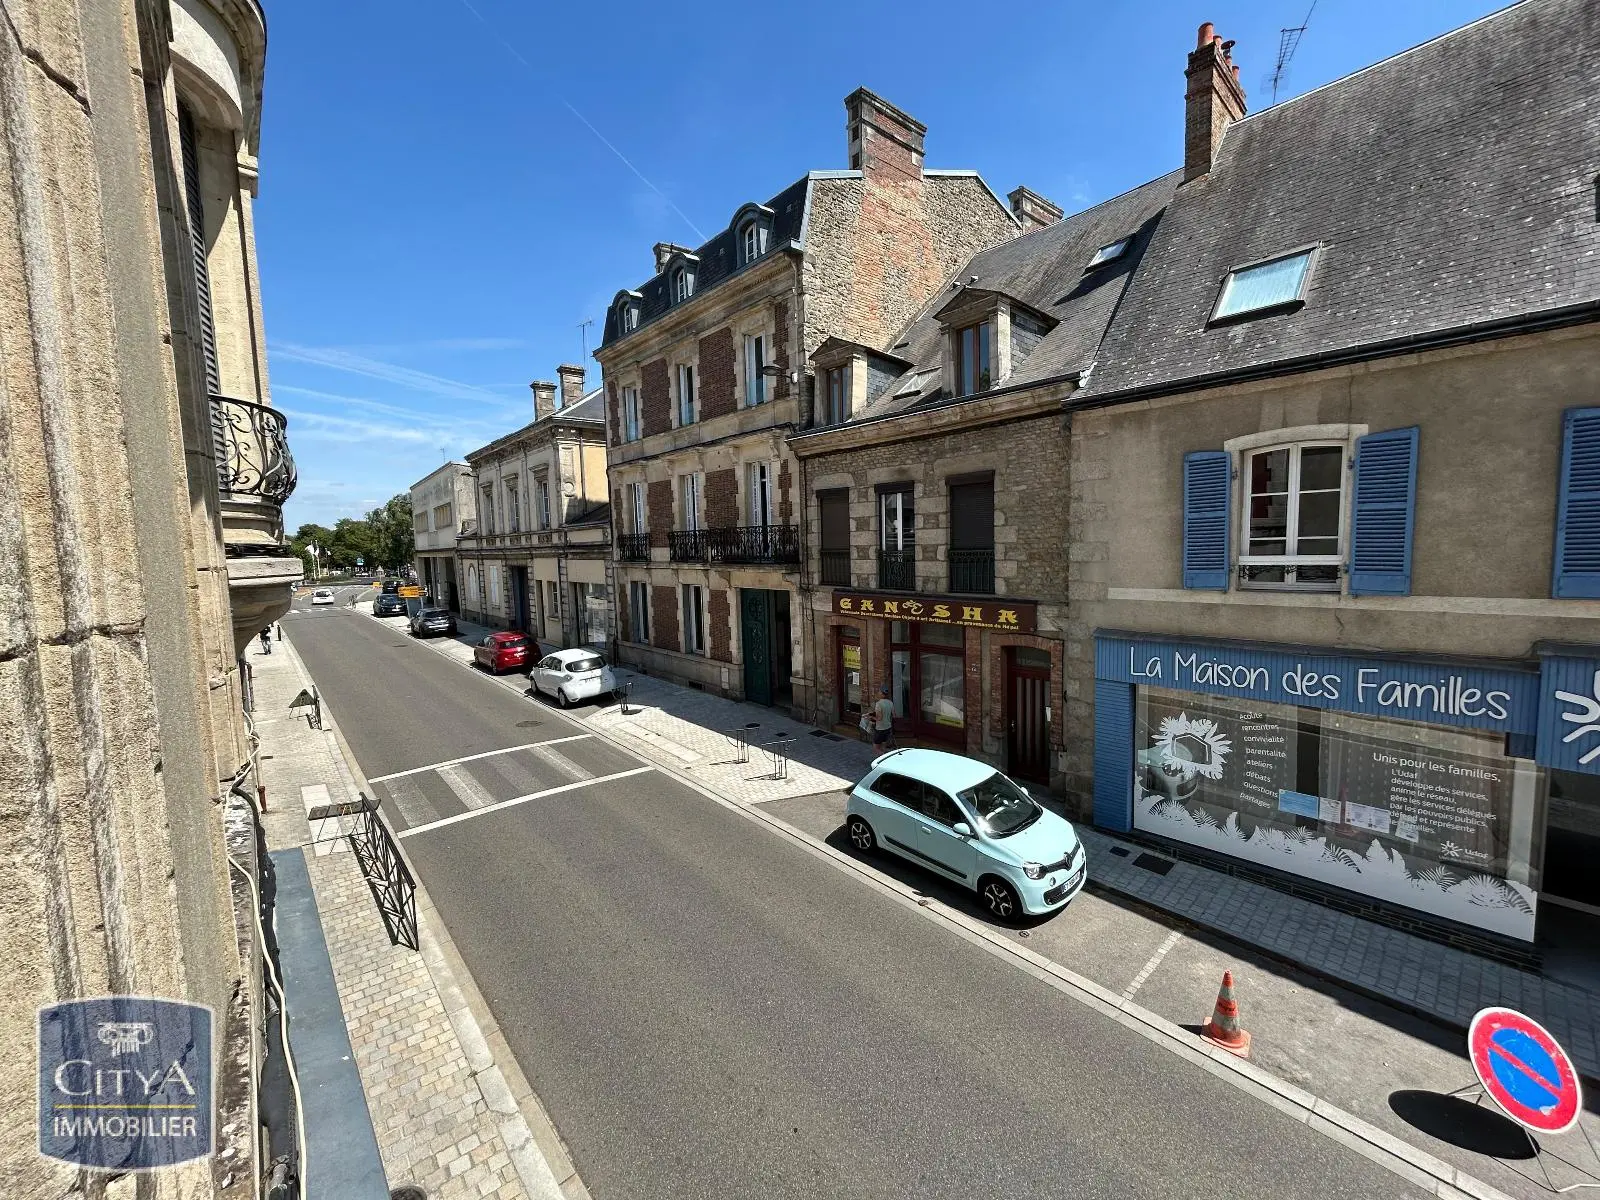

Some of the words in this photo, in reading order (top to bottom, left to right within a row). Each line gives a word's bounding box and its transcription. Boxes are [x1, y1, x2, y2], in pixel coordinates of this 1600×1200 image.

[1130, 646, 1162, 679] La
[1175, 651, 1269, 691] Maison
[1282, 663, 1341, 700] des
[1357, 668, 1511, 720] Familles
[1241, 723, 1279, 731] rencontres
[1243, 735, 1285, 743] convivialité
[1245, 747, 1287, 758] parentalité
[1246, 760, 1273, 769] ateliers
[1373, 752, 1398, 764] Unis
[1400, 757, 1426, 769] pour
[1429, 761, 1446, 773] les
[1448, 764, 1501, 783] familles.
[1245, 770, 1271, 783] débats
[1391, 768, 1419, 779] L'Udaf
[1243, 781, 1278, 798] questions
[1391, 777, 1434, 791] développe
[1435, 785, 1450, 794] des
[1240, 792, 1271, 809] partages
[1390, 786, 1417, 796] anime
[1418, 790, 1426, 798] le
[1427, 792, 1457, 804] réseau,
[1389, 803, 1403, 811] par
[1405, 804, 1417, 813] les
[1418, 809, 1453, 821] pouvoirs
[1390, 794, 1408, 803] gère
[1409, 797, 1420, 805] les
[1422, 799, 1455, 812] services
[1456, 807, 1497, 820] délégués
[1420, 816, 1428, 824] et
[1429, 819, 1476, 834] représente
